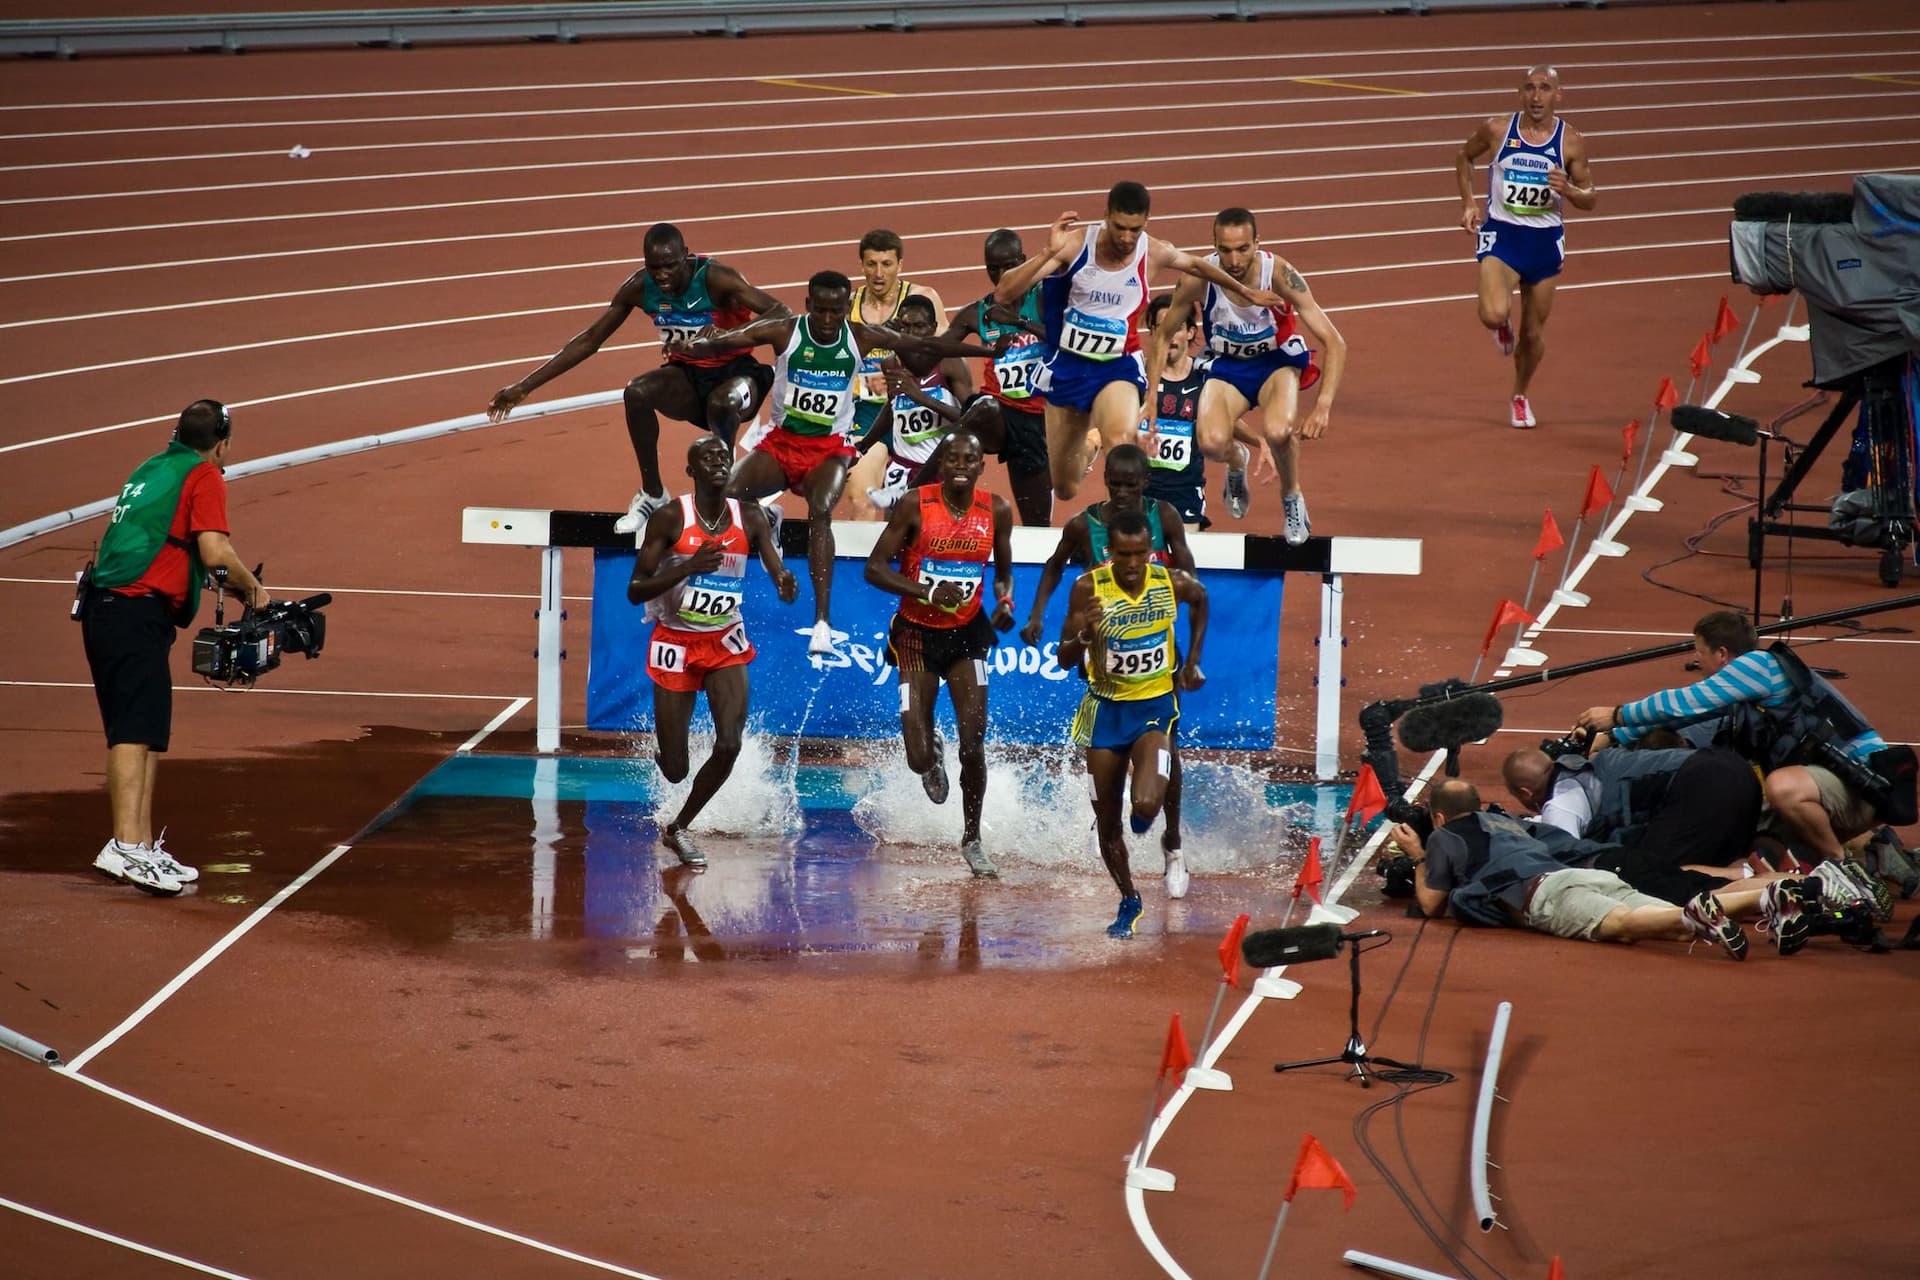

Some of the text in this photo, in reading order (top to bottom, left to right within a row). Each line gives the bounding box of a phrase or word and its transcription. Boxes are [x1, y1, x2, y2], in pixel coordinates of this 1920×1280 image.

[1511, 157, 1549, 171] MOLDOVA
[1506, 184, 1551, 207] 2429
[1089, 290, 1123, 306] FRANCE
[1068, 328, 1118, 354] 1777
[791, 387, 838, 417] 1682
[1161, 394, 1194, 418] SA
[898, 410, 941, 434] 269
[1160, 438, 1184, 461] 66
[930, 537, 978, 552] uganda
[689, 590, 736, 616] 1262
[1109, 605, 1165, 627] sweden
[657, 645, 676, 669] 10
[794, 628, 1069, 686] Beij 008
[1111, 647, 1164, 674] 2959
